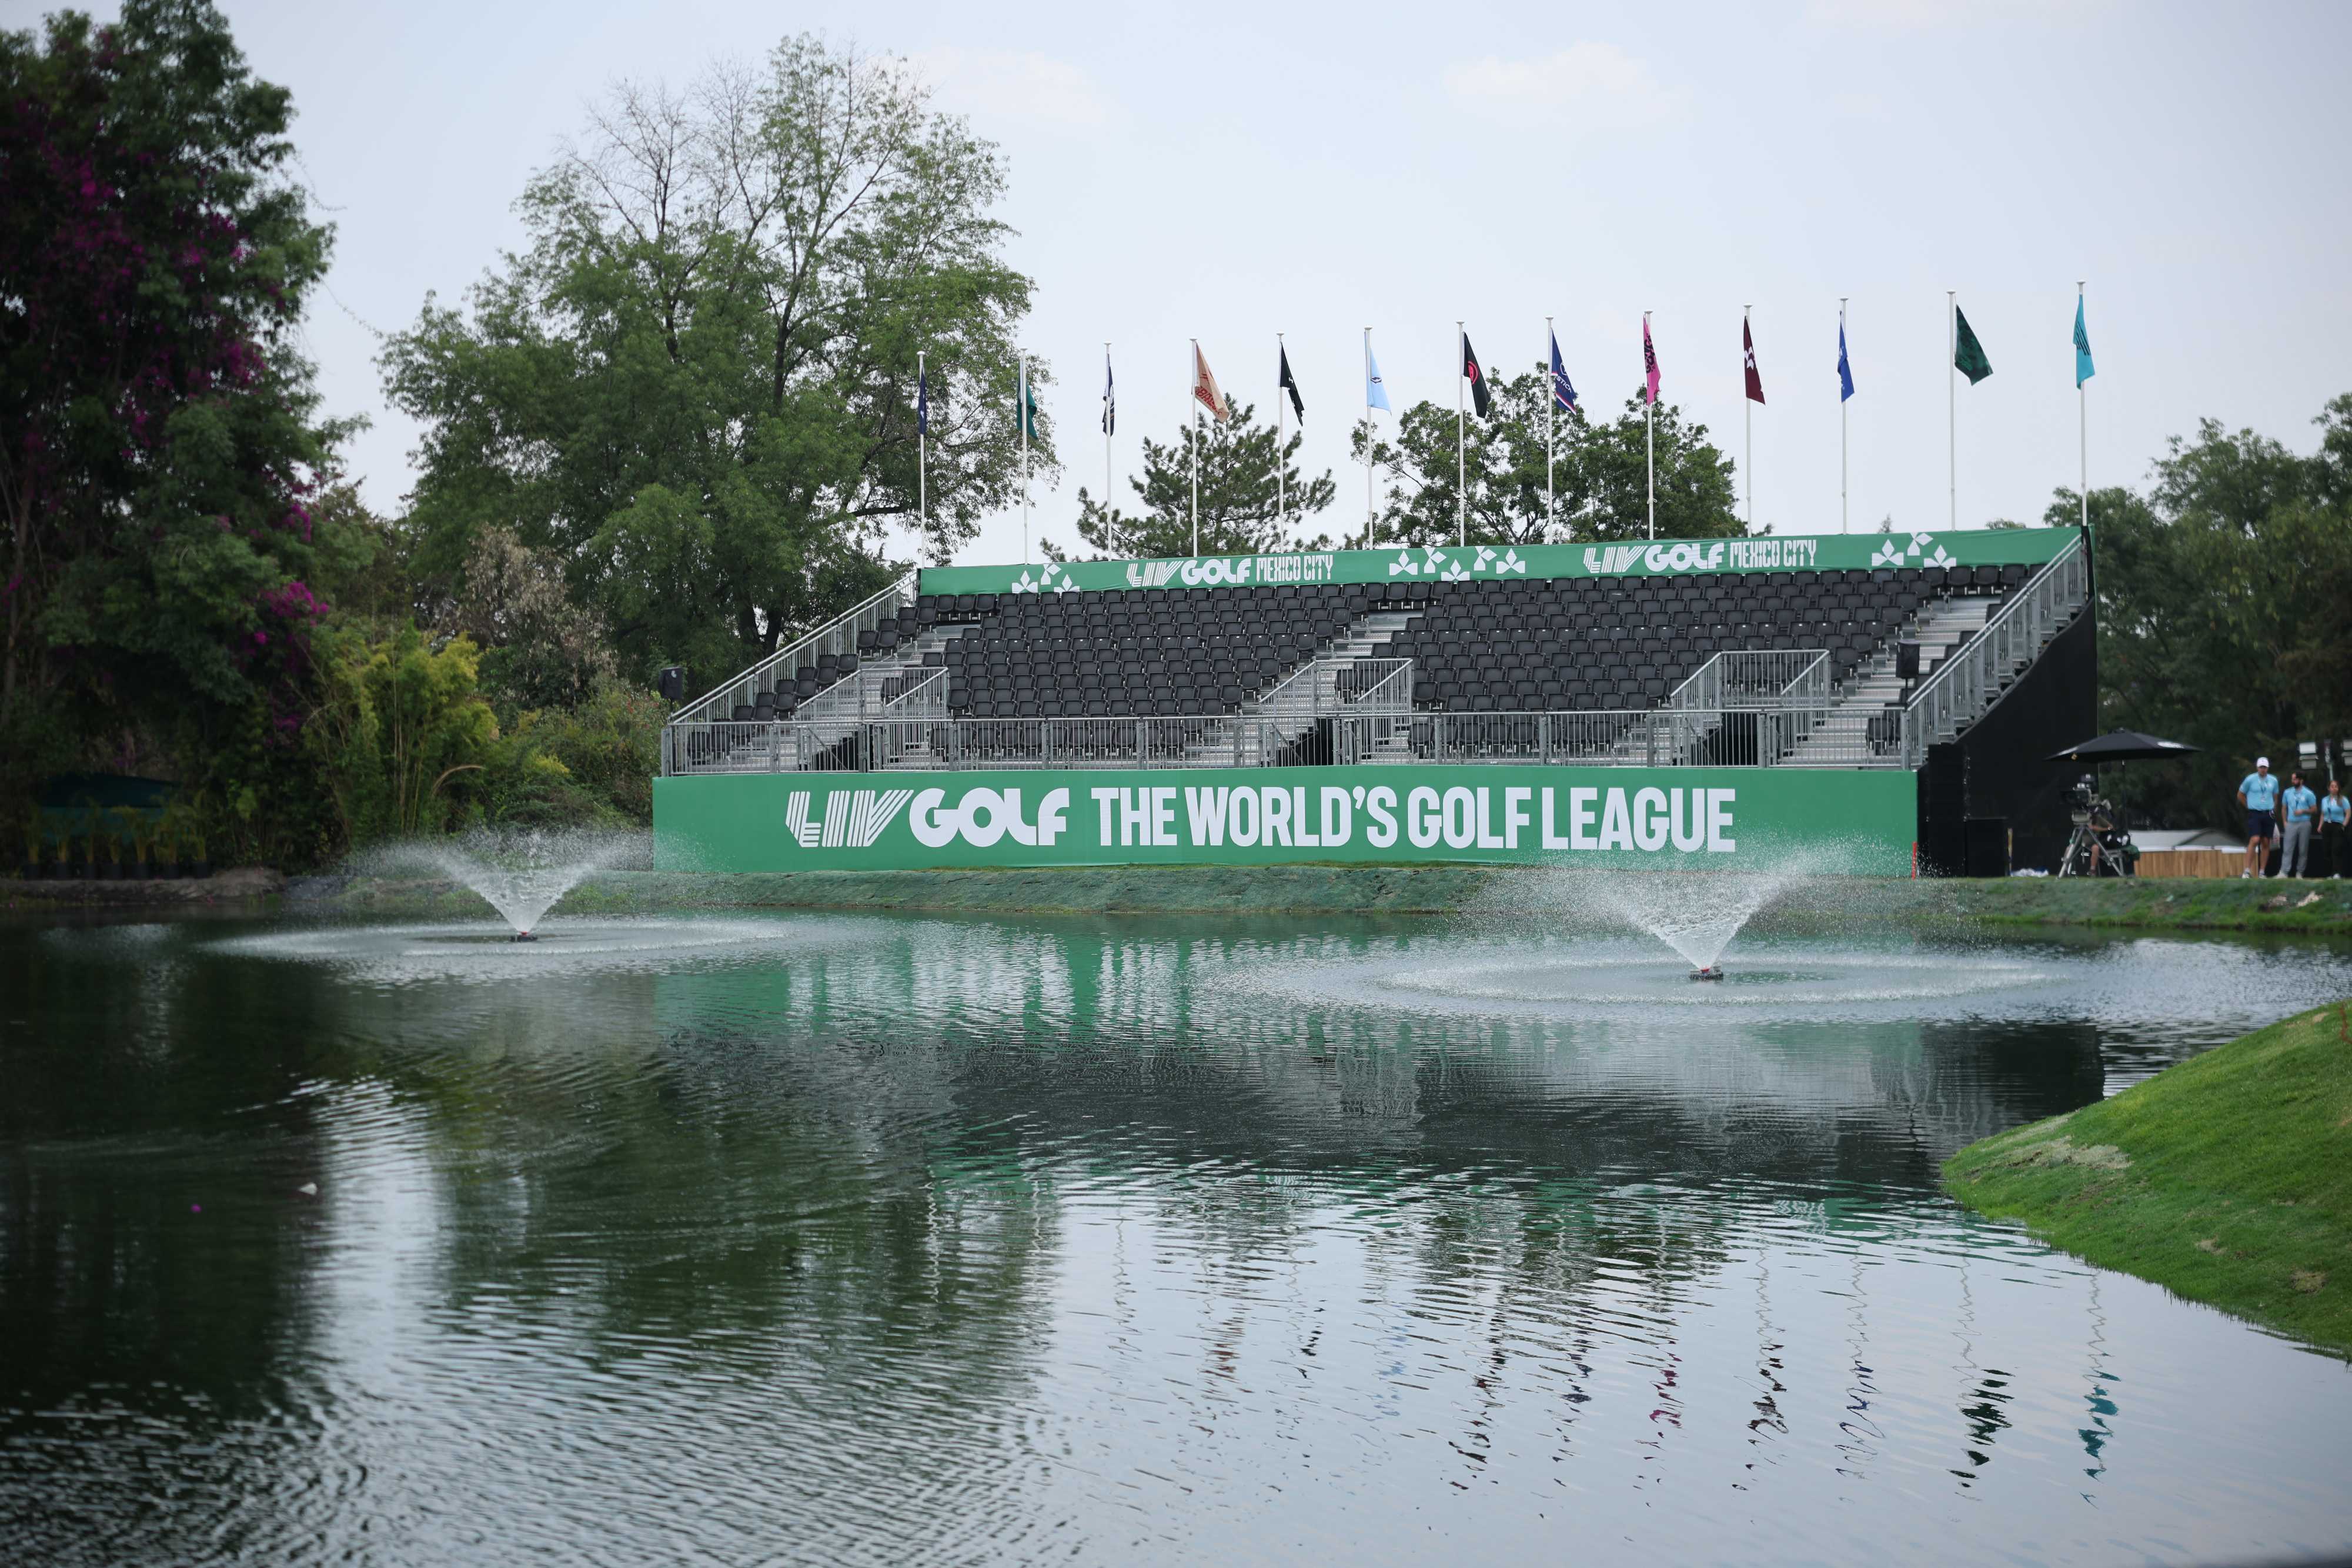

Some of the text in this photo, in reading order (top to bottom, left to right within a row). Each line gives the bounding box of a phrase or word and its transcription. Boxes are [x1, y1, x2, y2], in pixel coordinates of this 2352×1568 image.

[1126, 554, 1334, 587] LIV GOLF MEXICO CITY
[1583, 539, 1817, 574] LIV GOLF MEXICO CITY
[785, 786, 1736, 852] LIV GOLF THE WORLD'S GOLF LEAGUE
